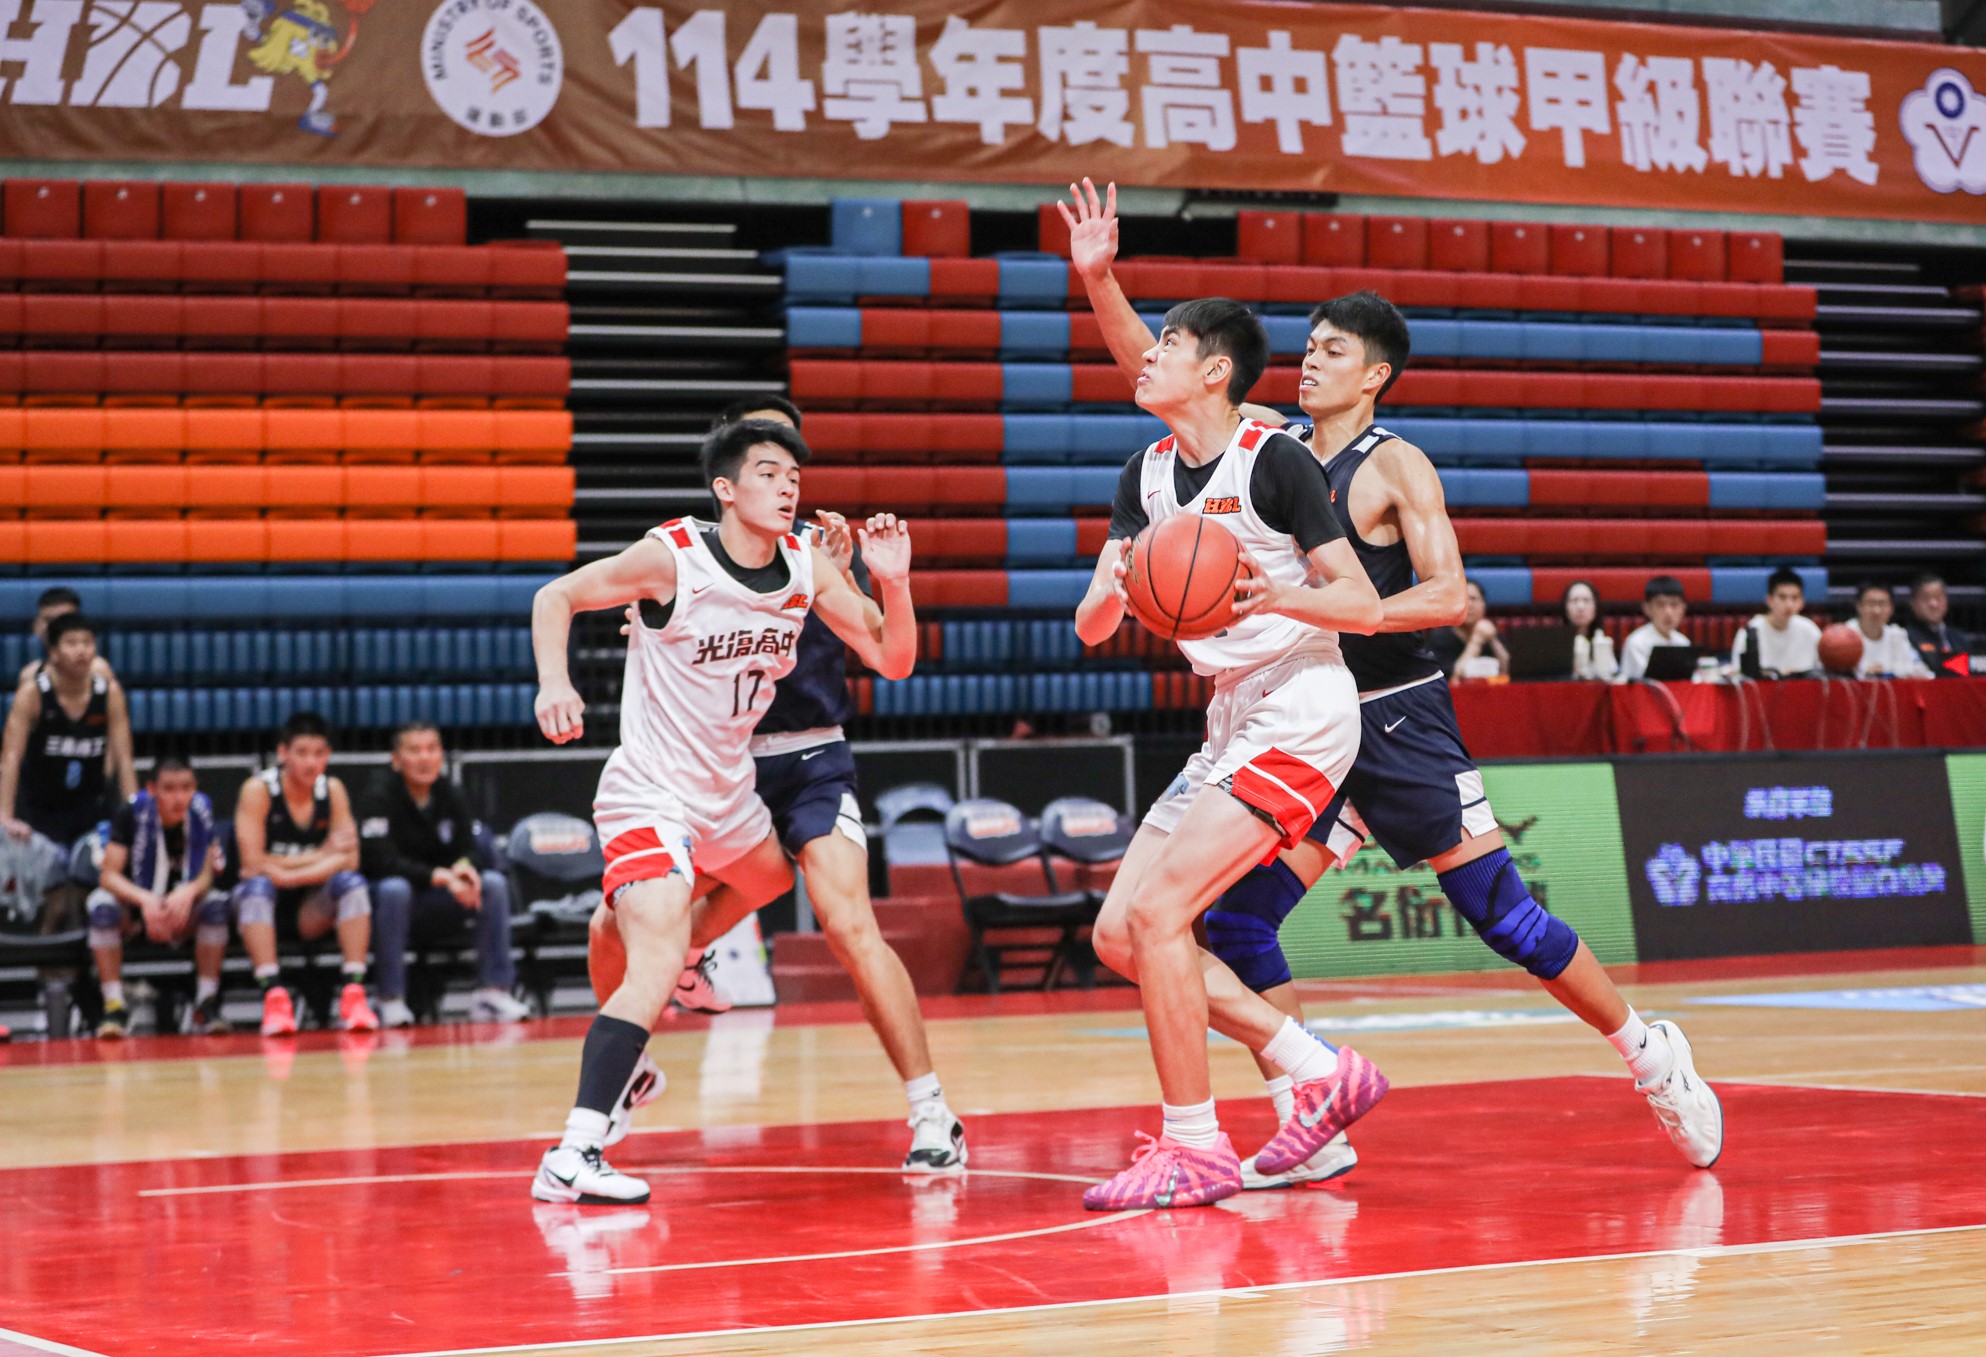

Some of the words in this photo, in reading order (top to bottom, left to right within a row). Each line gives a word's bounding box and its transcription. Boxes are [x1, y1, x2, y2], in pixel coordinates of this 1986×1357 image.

[516, 7, 555, 85] SPORTS
[607, 6, 1880, 185] 114學年度高中籃球甲級聯賽
[731, 669, 766, 717] 17
